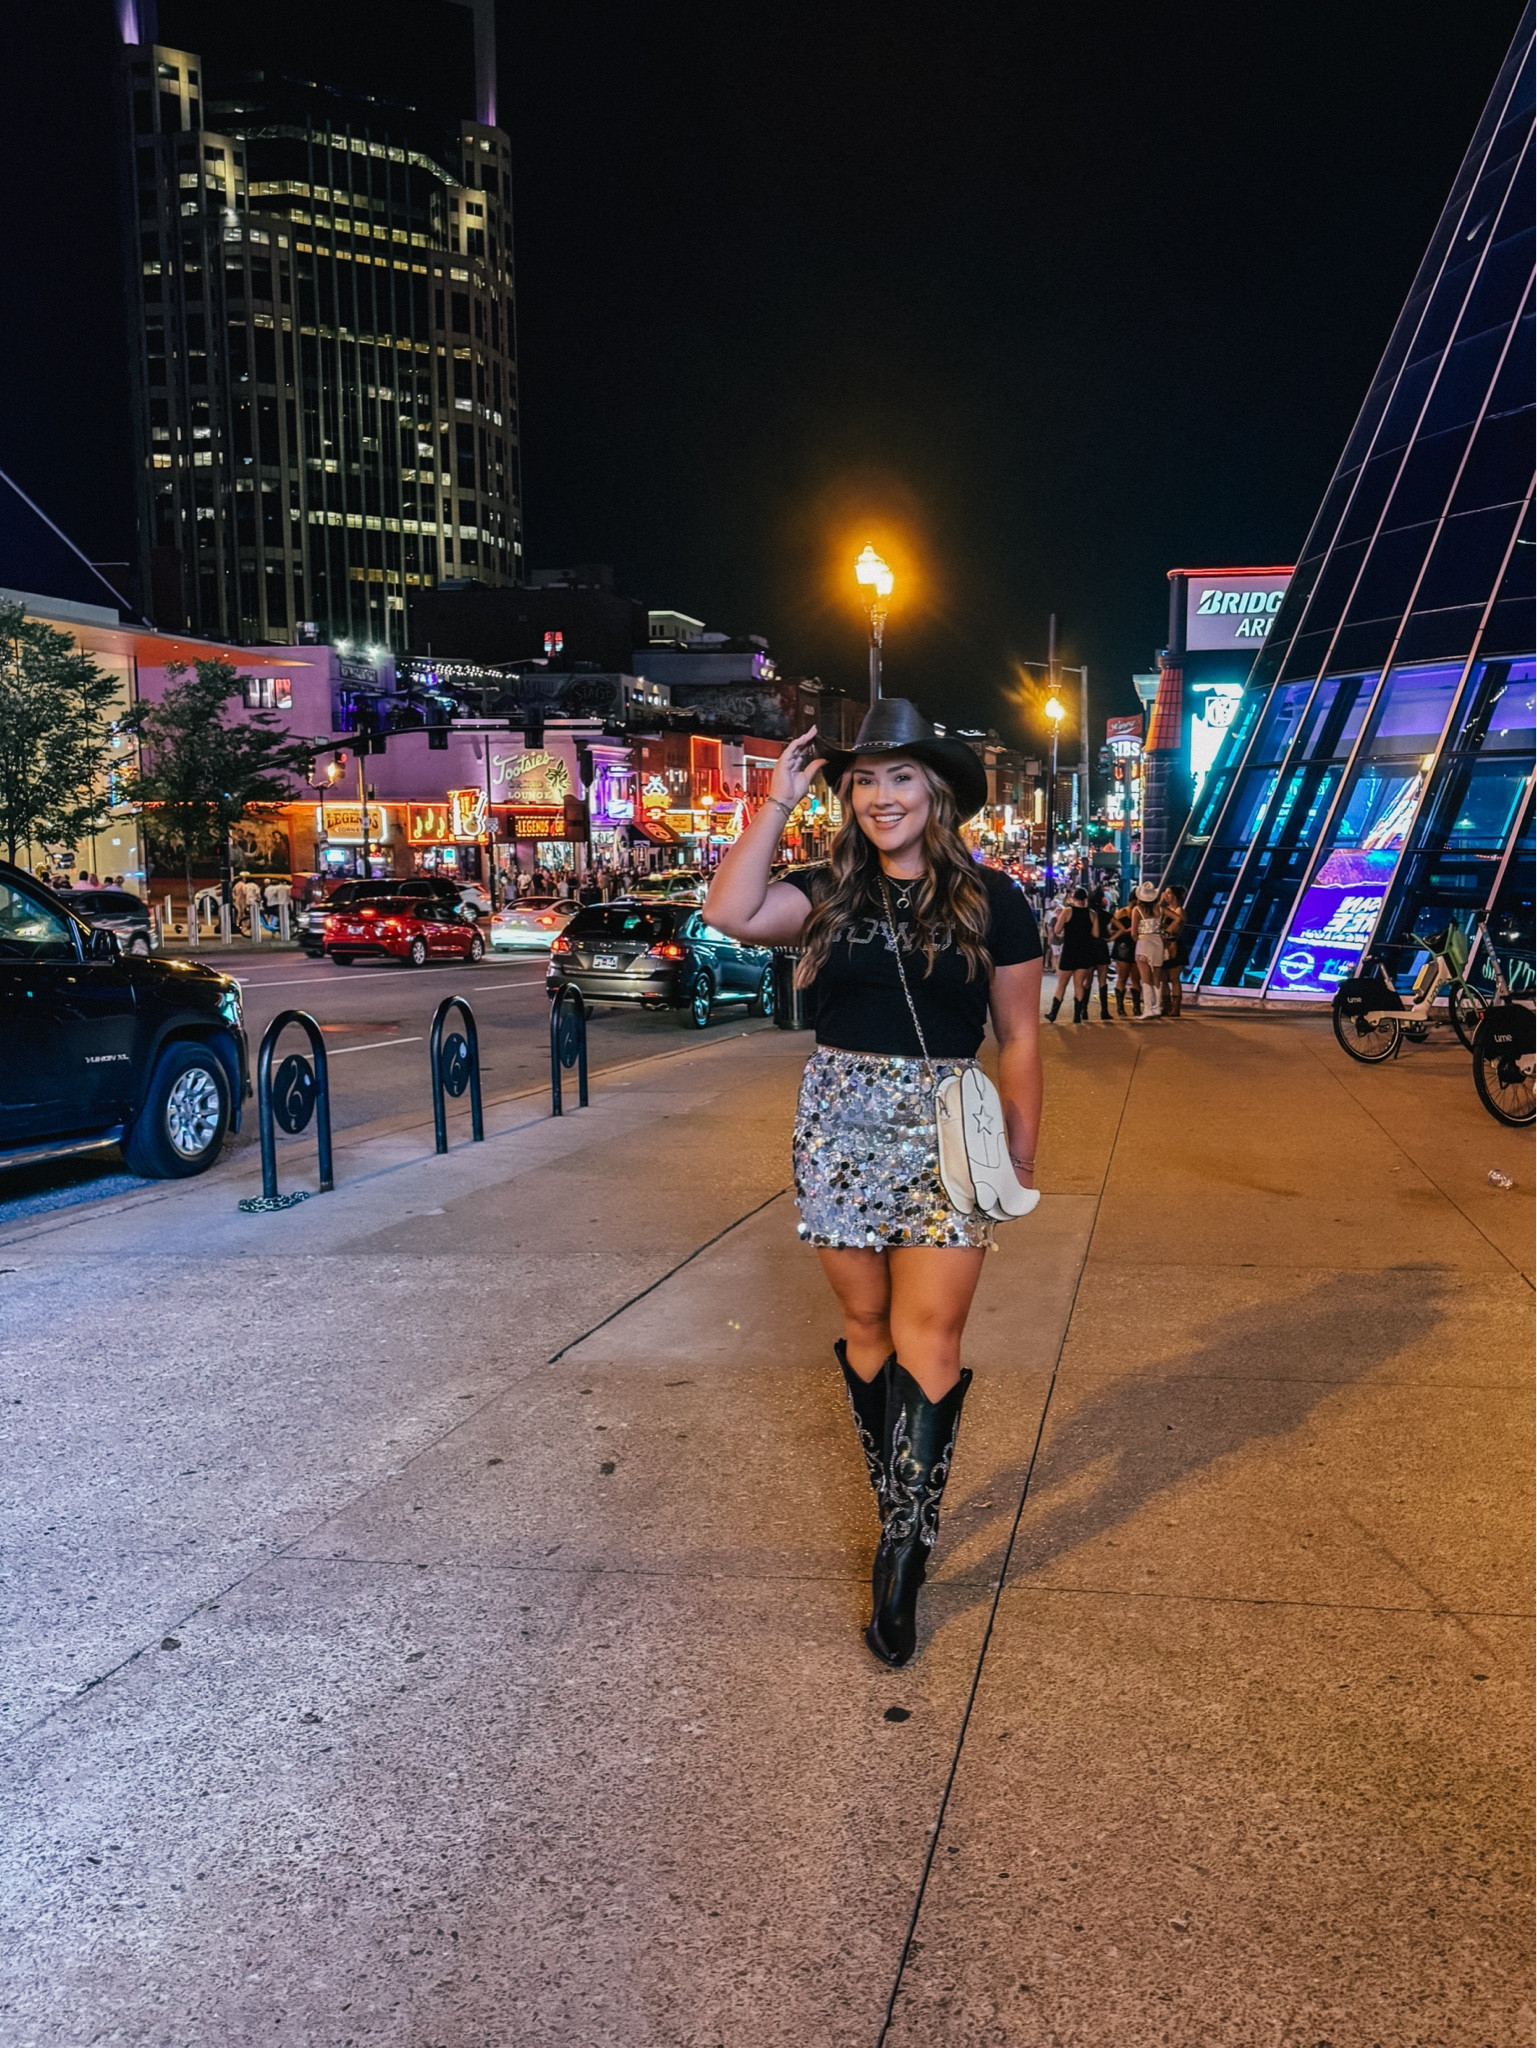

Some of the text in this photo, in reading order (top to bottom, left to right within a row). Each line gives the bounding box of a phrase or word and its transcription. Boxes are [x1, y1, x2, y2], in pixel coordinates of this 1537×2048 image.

[508, 791, 553, 800] LOUNGE
[326, 812, 379, 829] LEGENS
[518, 820, 549, 833] LEGENDS
[84, 1055, 116, 1064] YUKON
